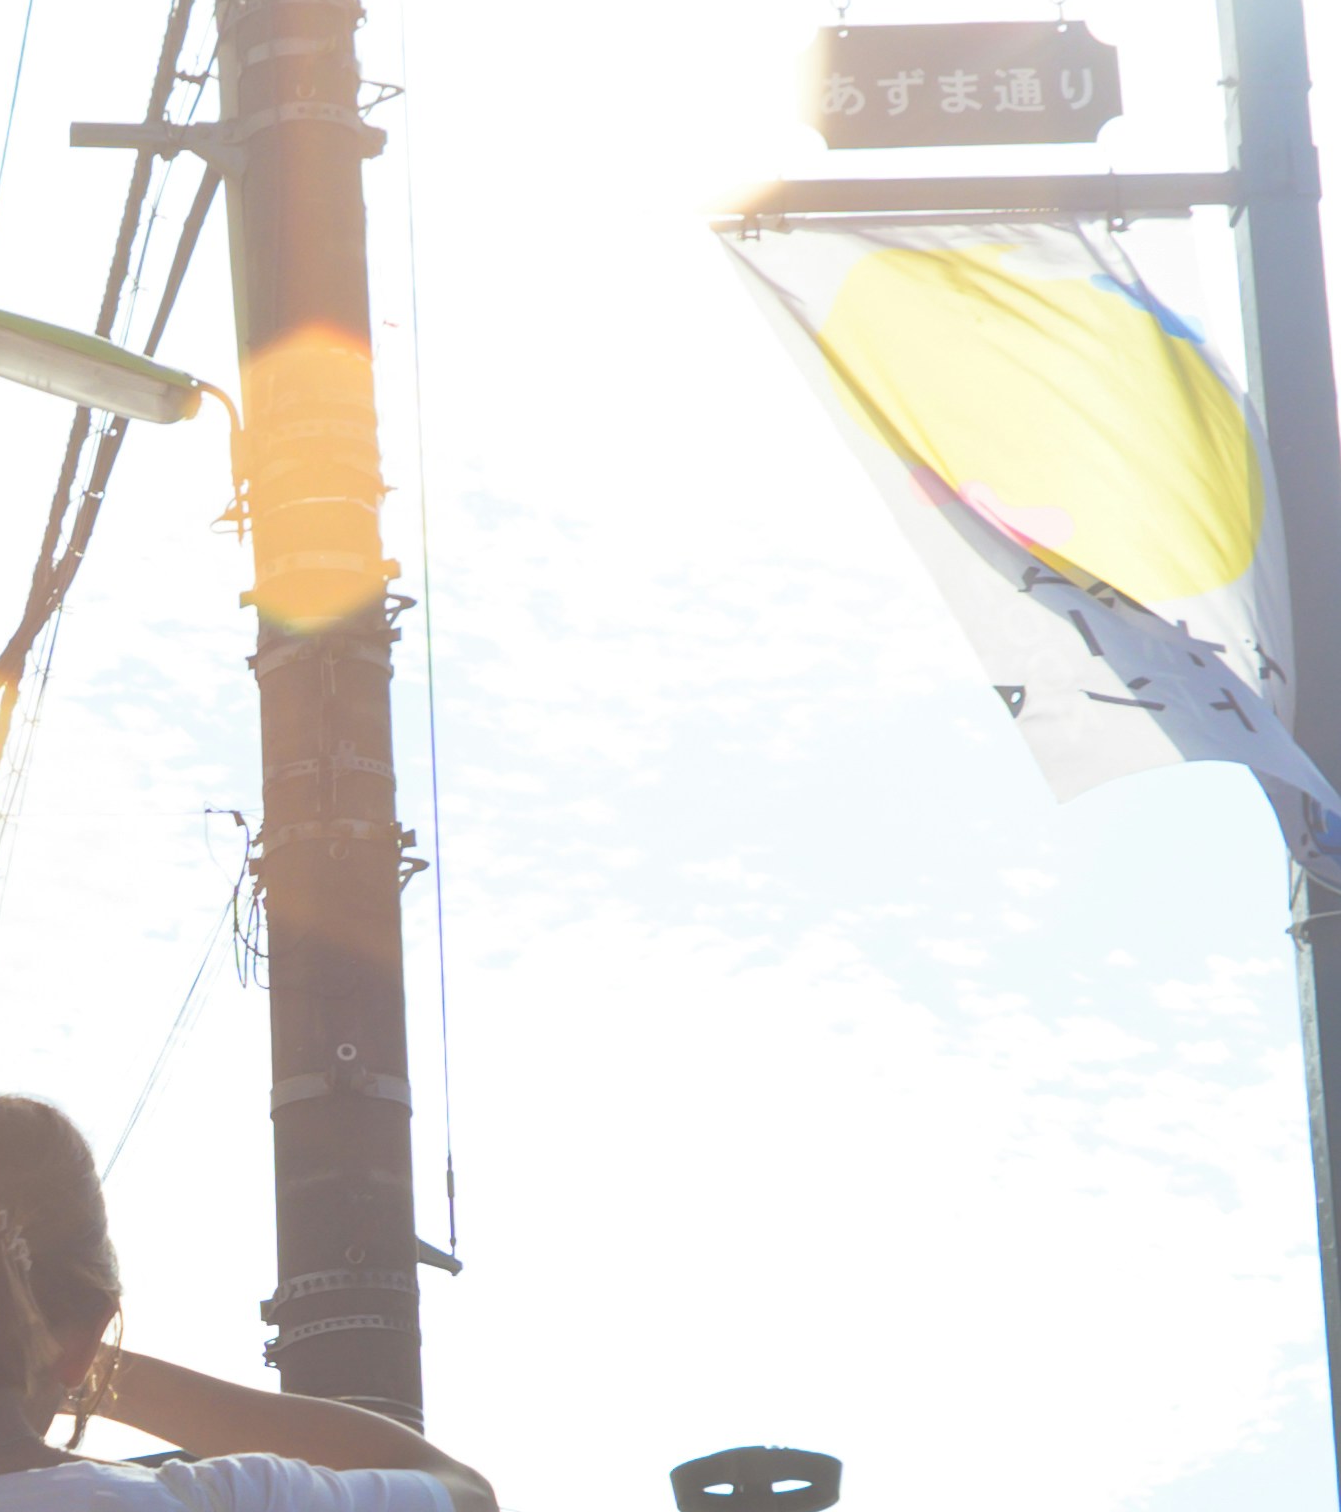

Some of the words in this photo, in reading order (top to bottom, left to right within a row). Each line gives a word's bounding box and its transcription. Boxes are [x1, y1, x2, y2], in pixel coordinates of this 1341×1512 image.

[820, 68, 1096, 116] あずま通り
